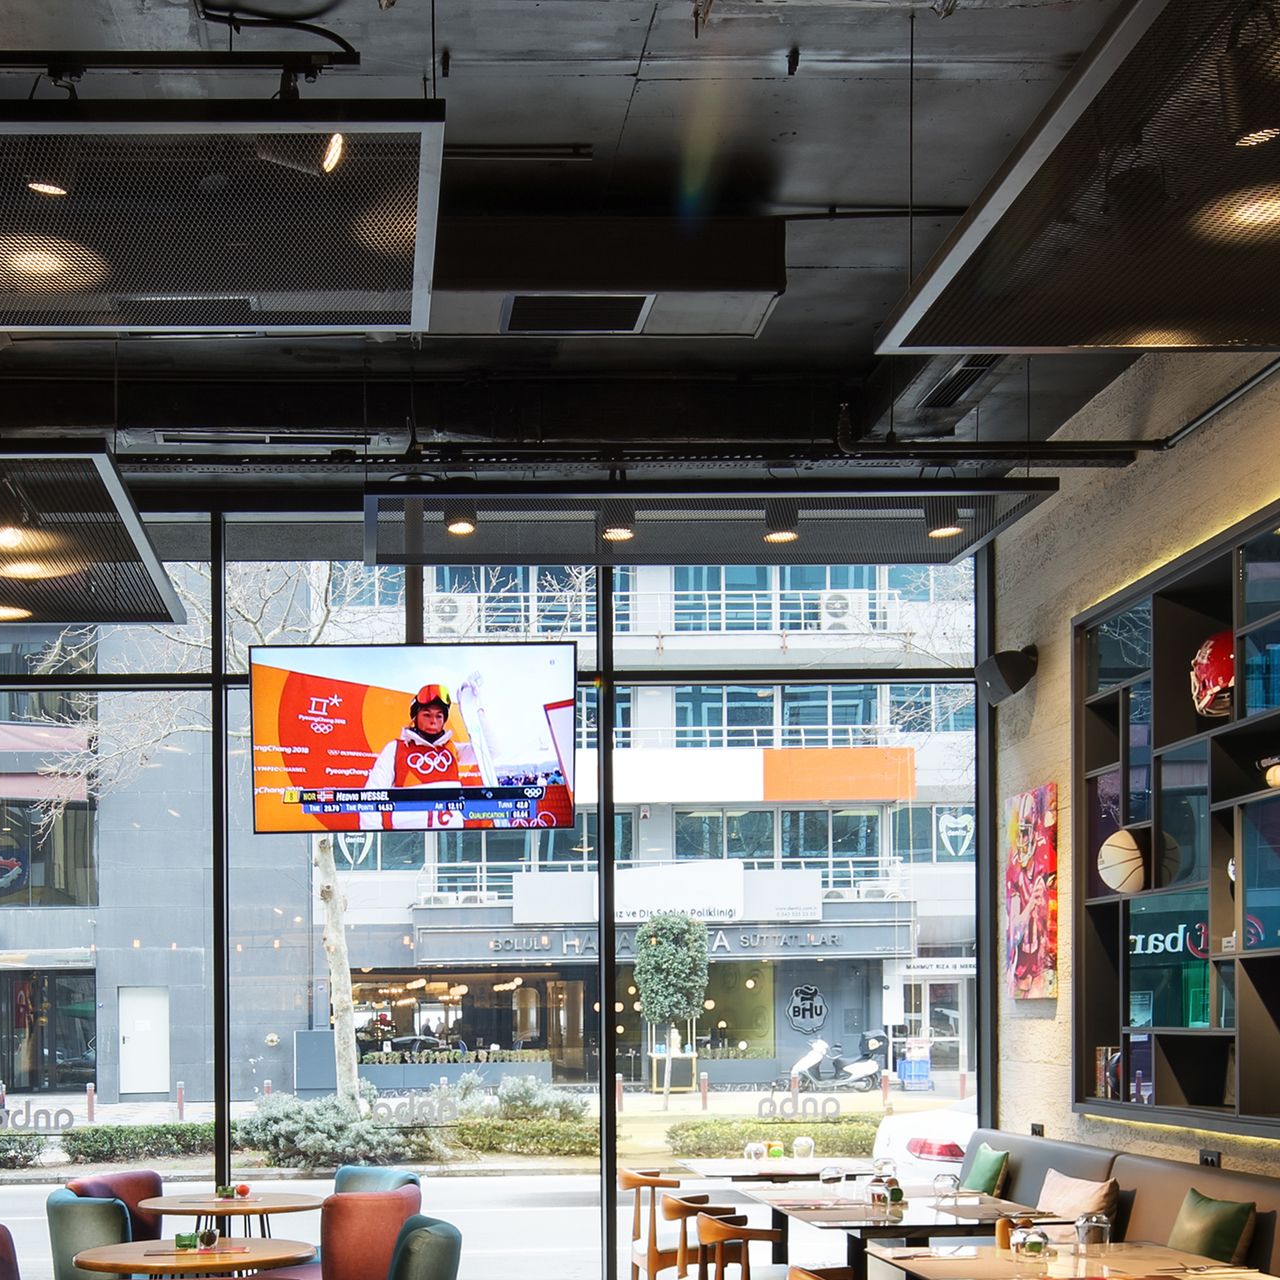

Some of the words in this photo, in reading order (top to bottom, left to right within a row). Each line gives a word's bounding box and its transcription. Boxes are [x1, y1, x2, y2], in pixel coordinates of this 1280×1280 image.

[292, 746, 310, 754] 2018
[360, 791, 390, 801] WESSEL
[626, 911, 638, 919] ve
[792, 1004, 823, 1020] BHU
